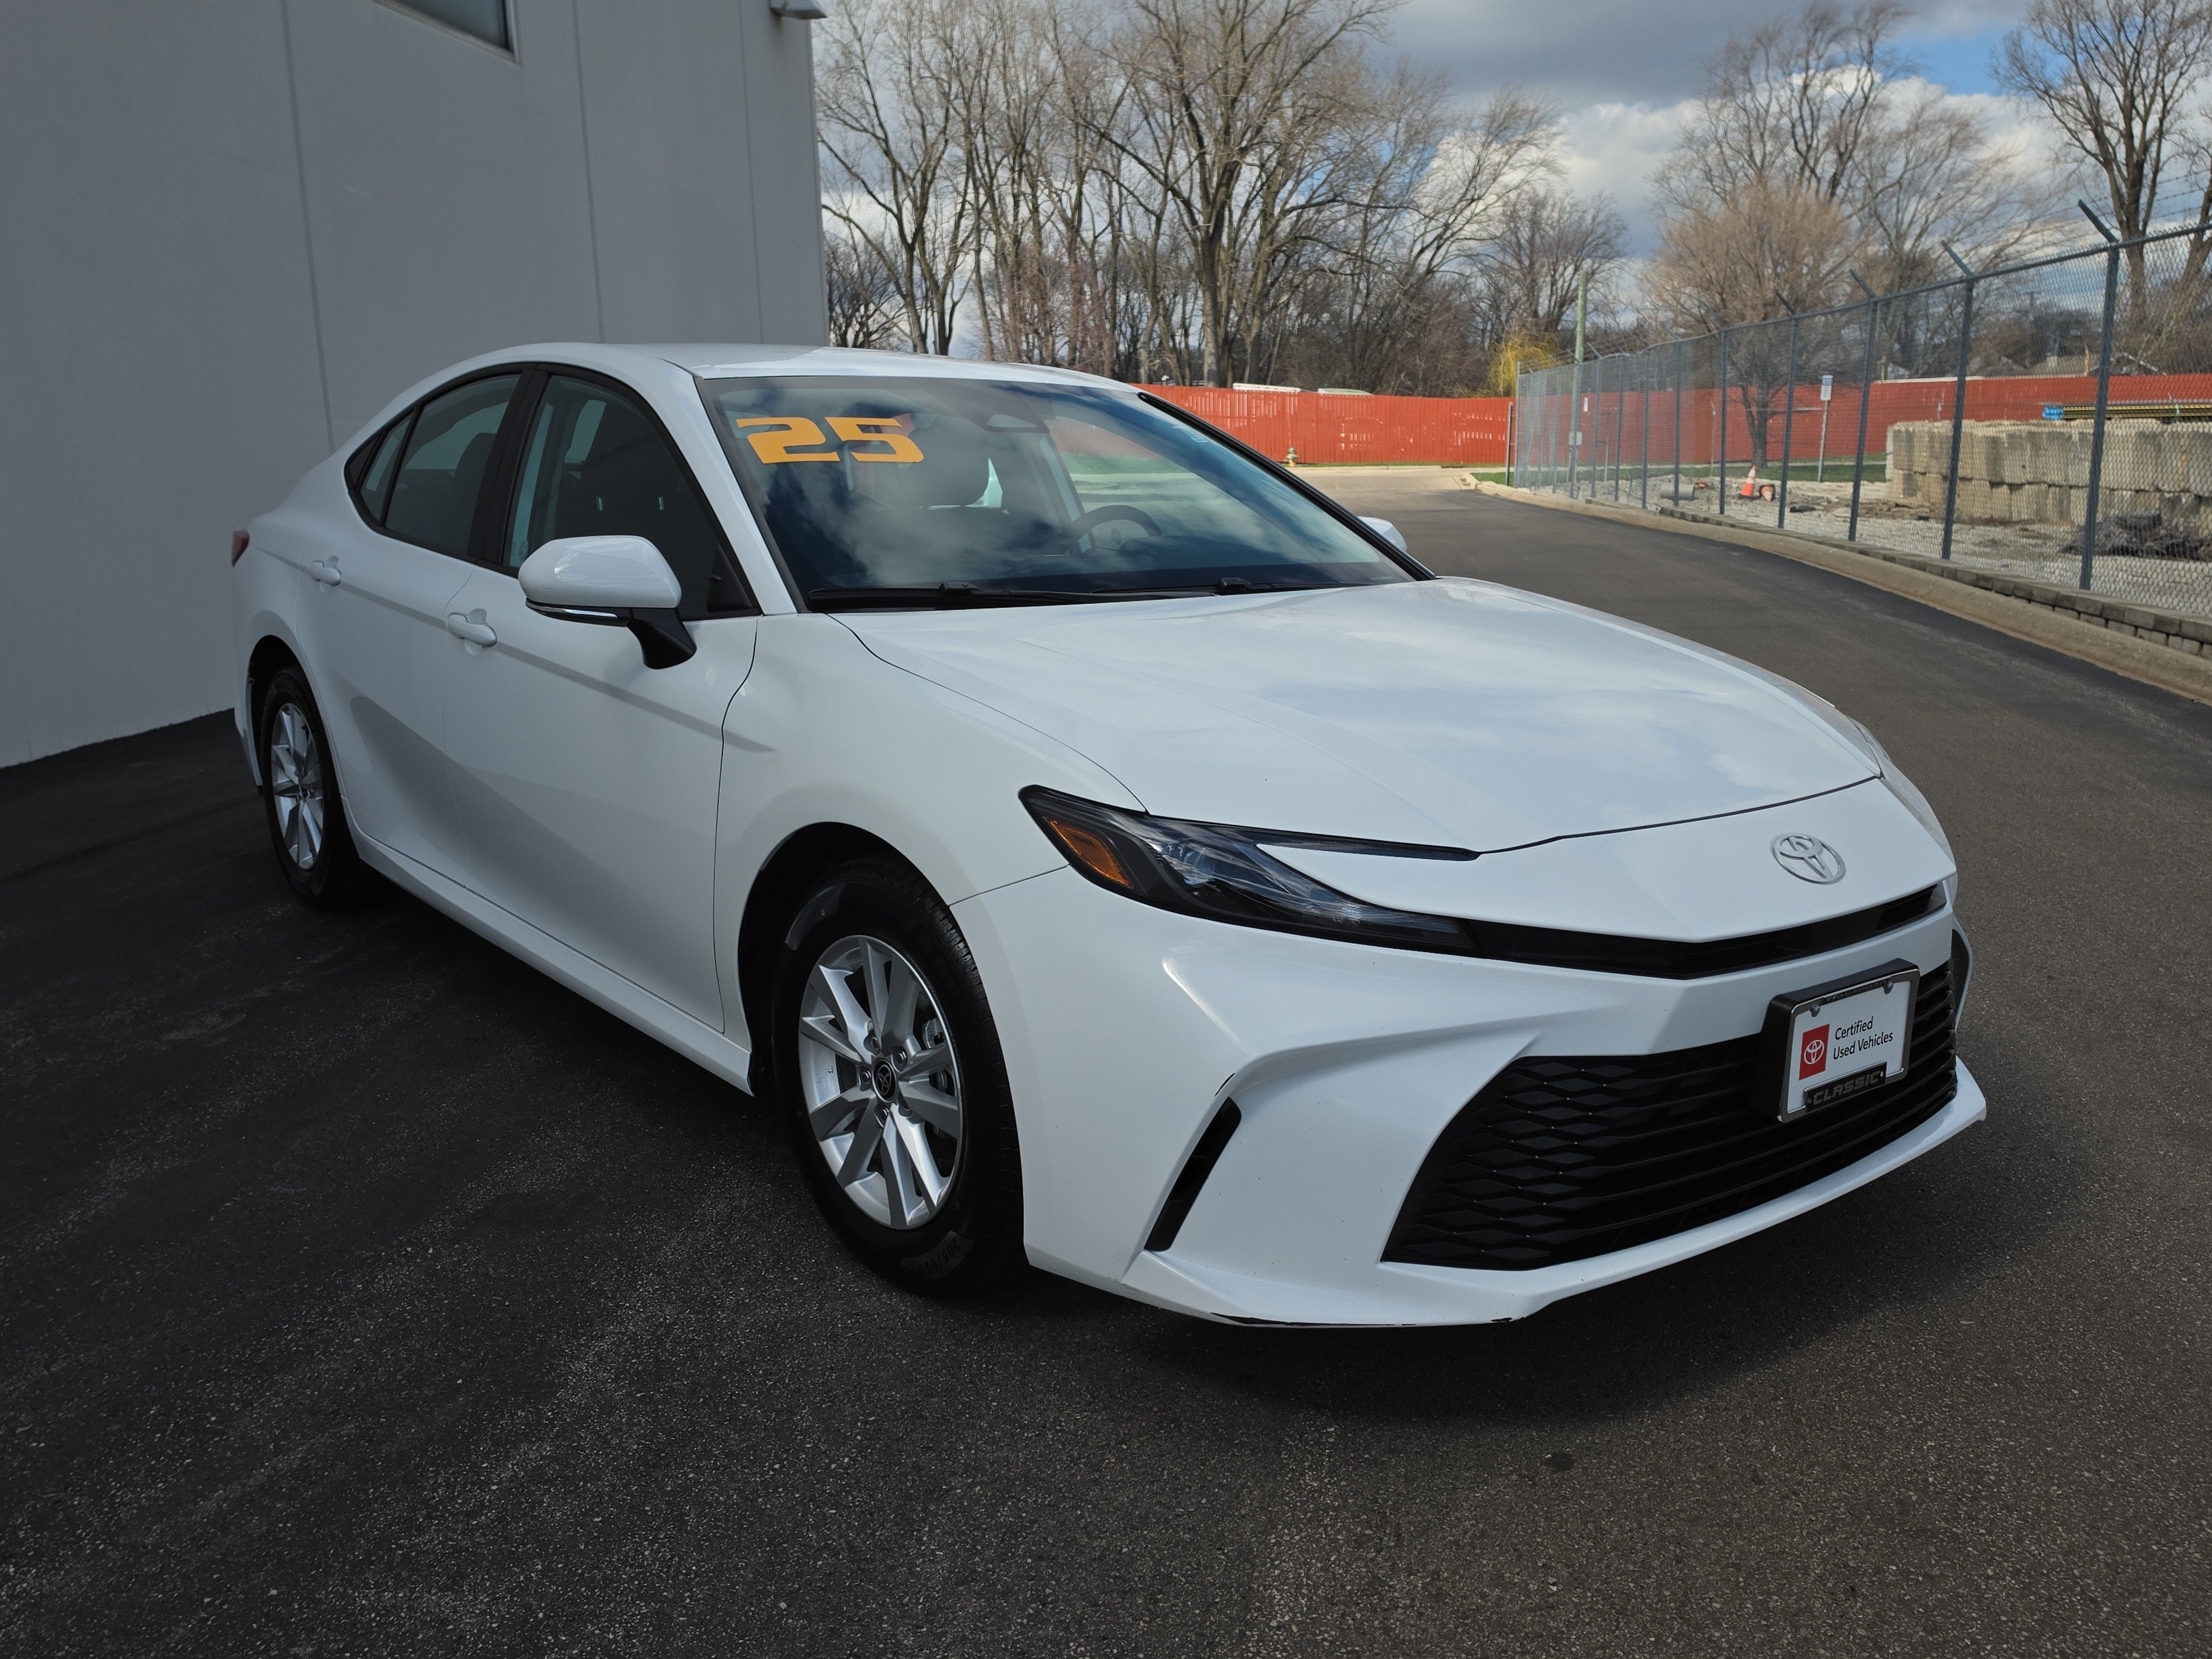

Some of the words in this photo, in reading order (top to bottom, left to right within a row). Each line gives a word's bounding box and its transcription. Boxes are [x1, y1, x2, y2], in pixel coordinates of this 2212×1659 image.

[736, 416, 924, 464] 25
[1835, 1015, 1874, 1040] Certified
[1833, 1040, 1856, 1060] Used
[1858, 1031, 1893, 1051] Vehicles
[1813, 1070, 1881, 1105] CLASSIC
